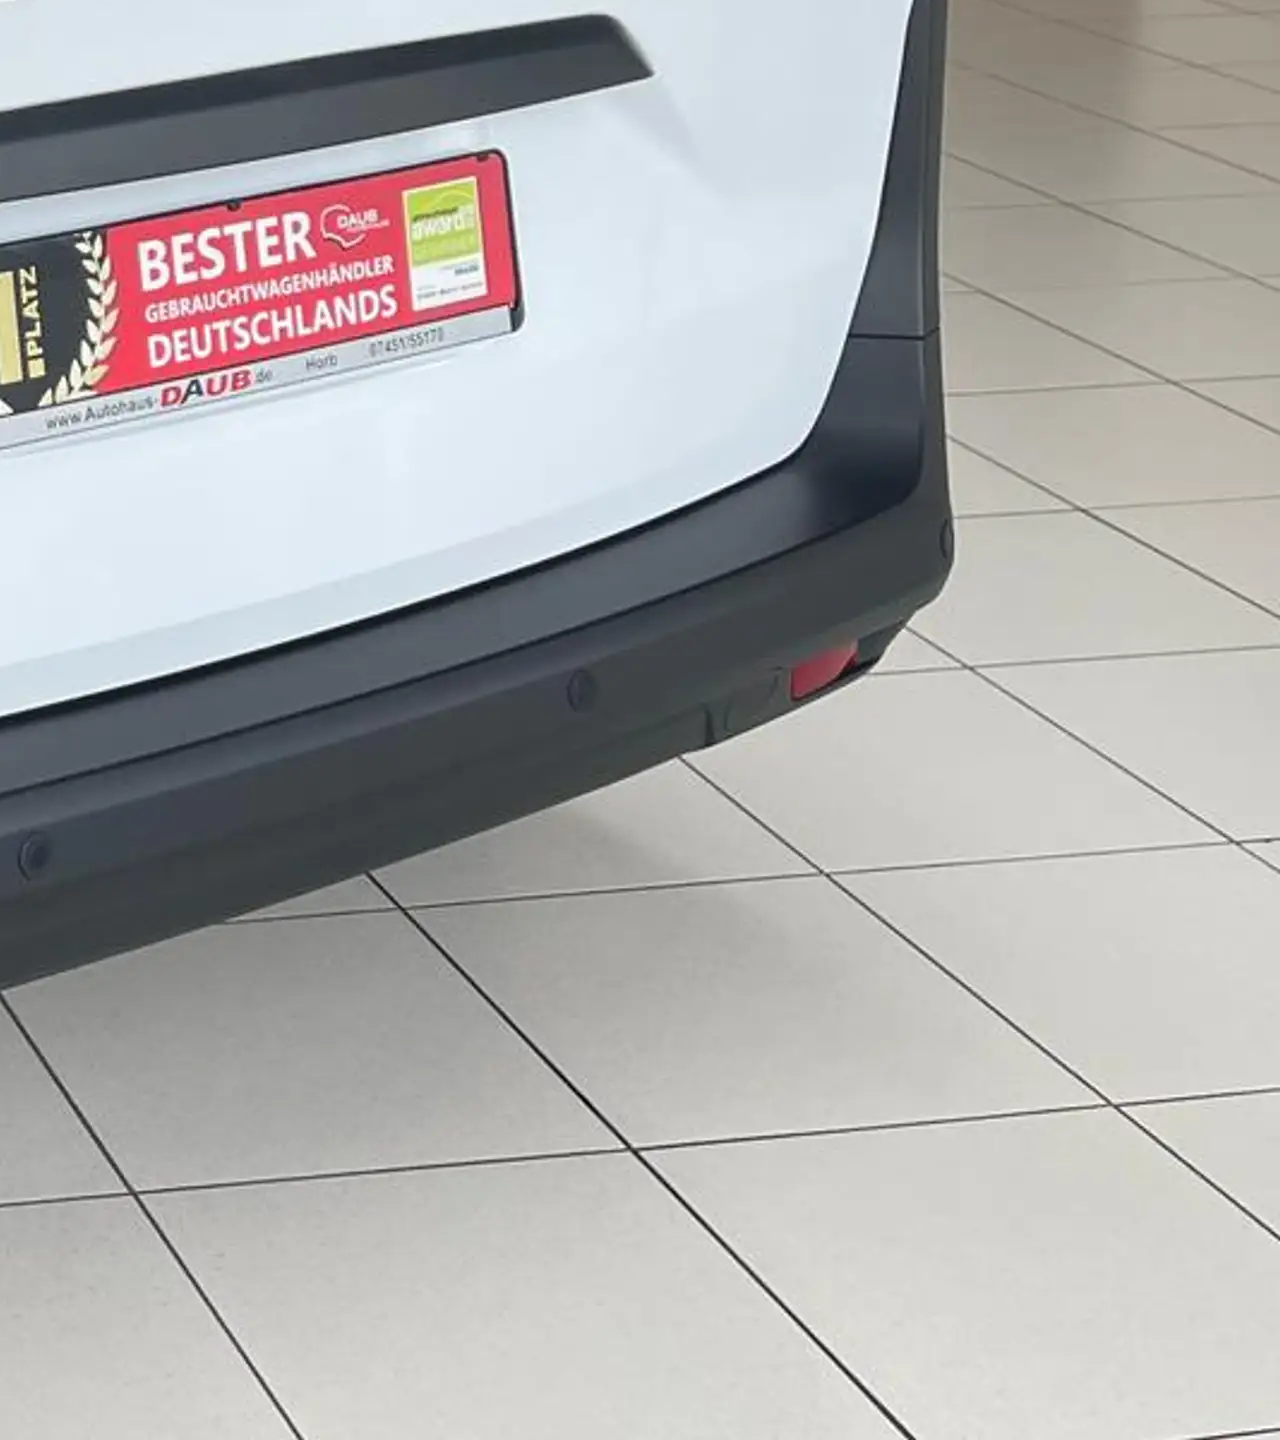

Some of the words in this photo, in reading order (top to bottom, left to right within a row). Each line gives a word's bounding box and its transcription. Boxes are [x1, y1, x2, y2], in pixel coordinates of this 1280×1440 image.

[137, 210, 317, 293] BESTER
[336, 208, 380, 230] DAUB
[19, 265, 44, 358] PLATZ
[144, 254, 395, 324] GEBRAUCHTWAGENHÄNDLER
[146, 283, 399, 370] DEUTSCHLANDS
[305, 353, 338, 372] Horb
